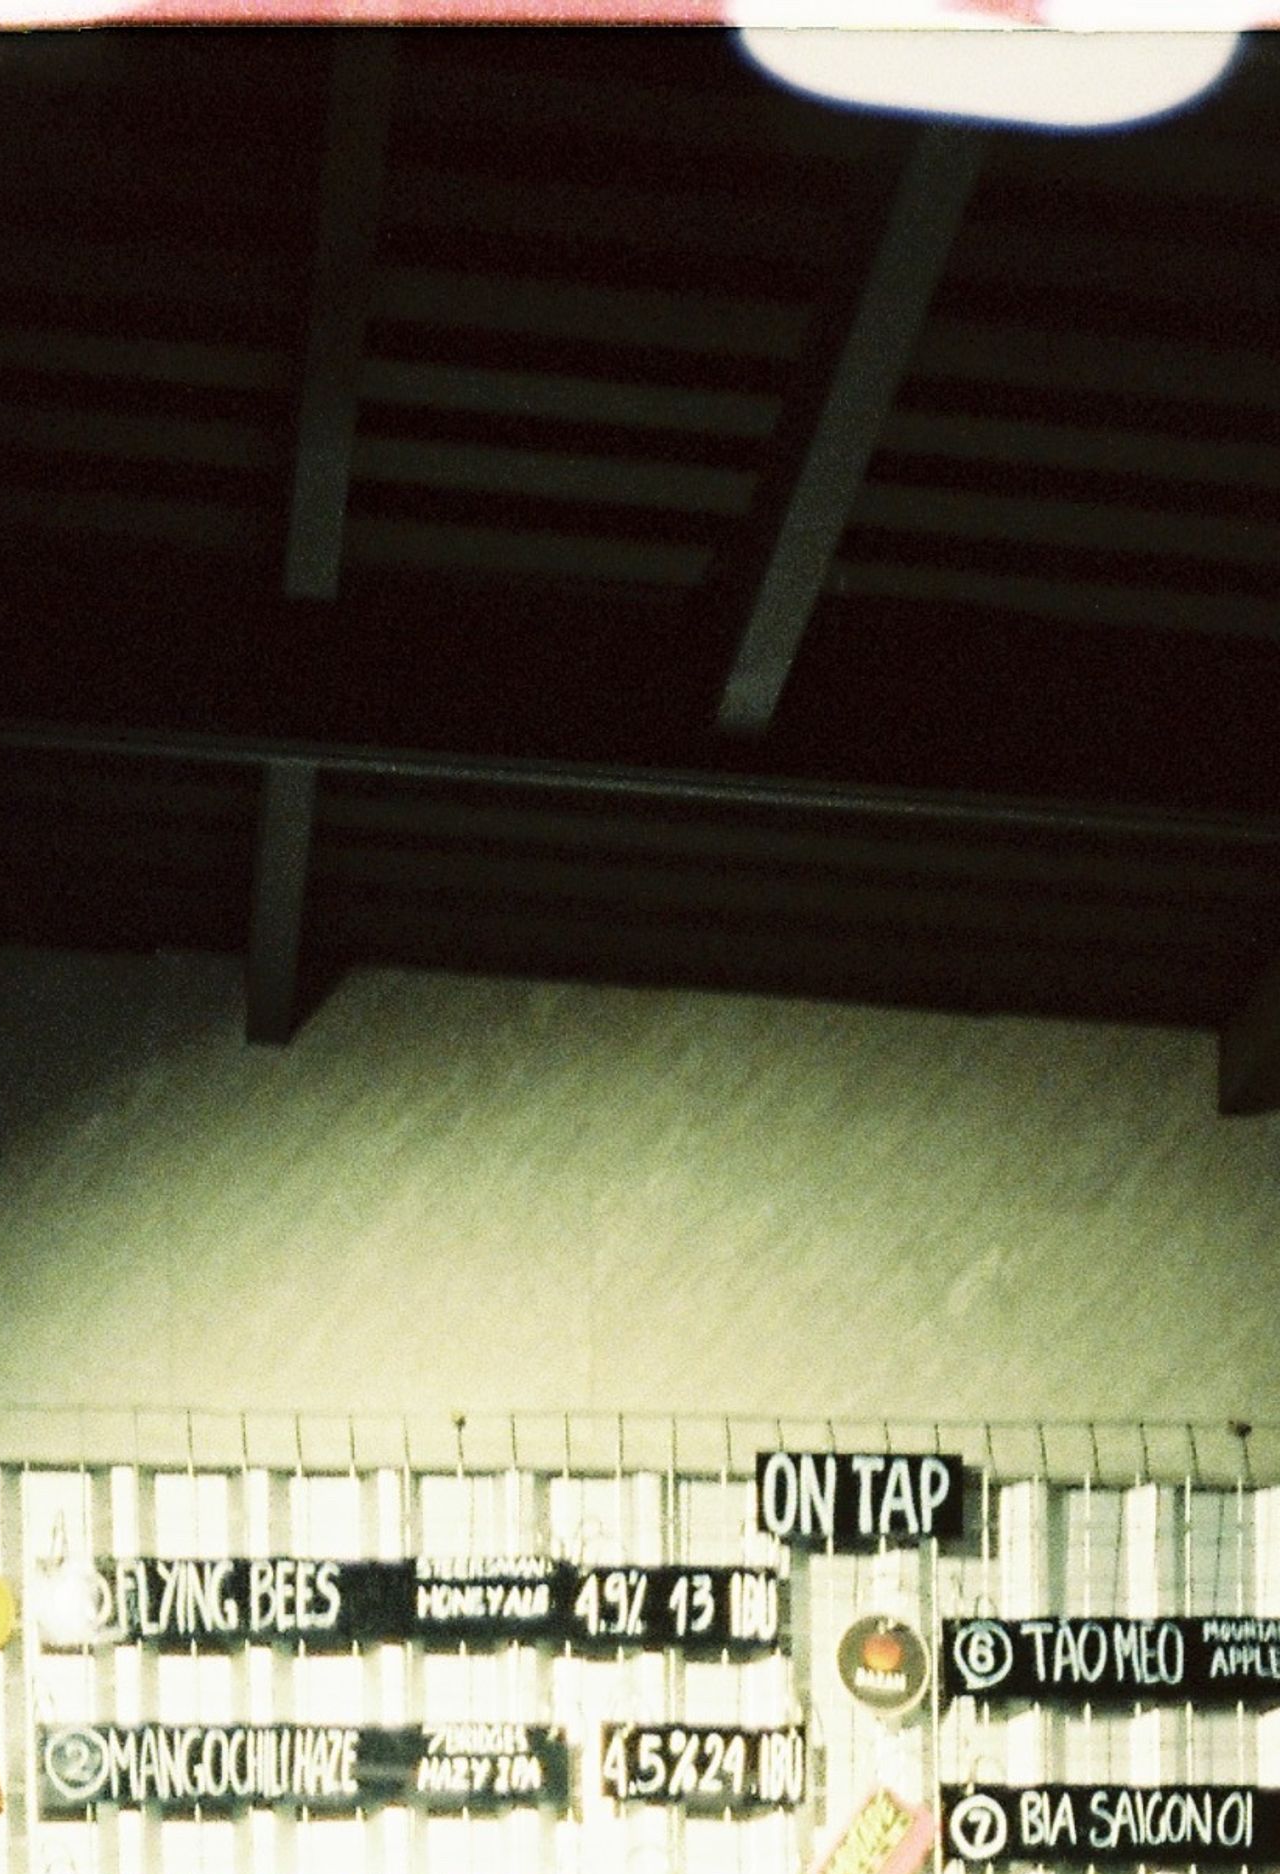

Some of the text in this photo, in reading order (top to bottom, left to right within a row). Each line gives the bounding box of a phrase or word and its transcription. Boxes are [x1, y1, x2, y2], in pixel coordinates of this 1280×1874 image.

[762, 1452, 950, 1536] ON TAP
[117, 1559, 341, 1635] FLYING BEES
[574, 1569, 648, 1636] 4.9%
[668, 1573, 715, 1637] 13
[494, 1755, 541, 1794] IPA
[1020, 1790, 1077, 1847] BIA
[1089, 1790, 1212, 1848] SAIGON
